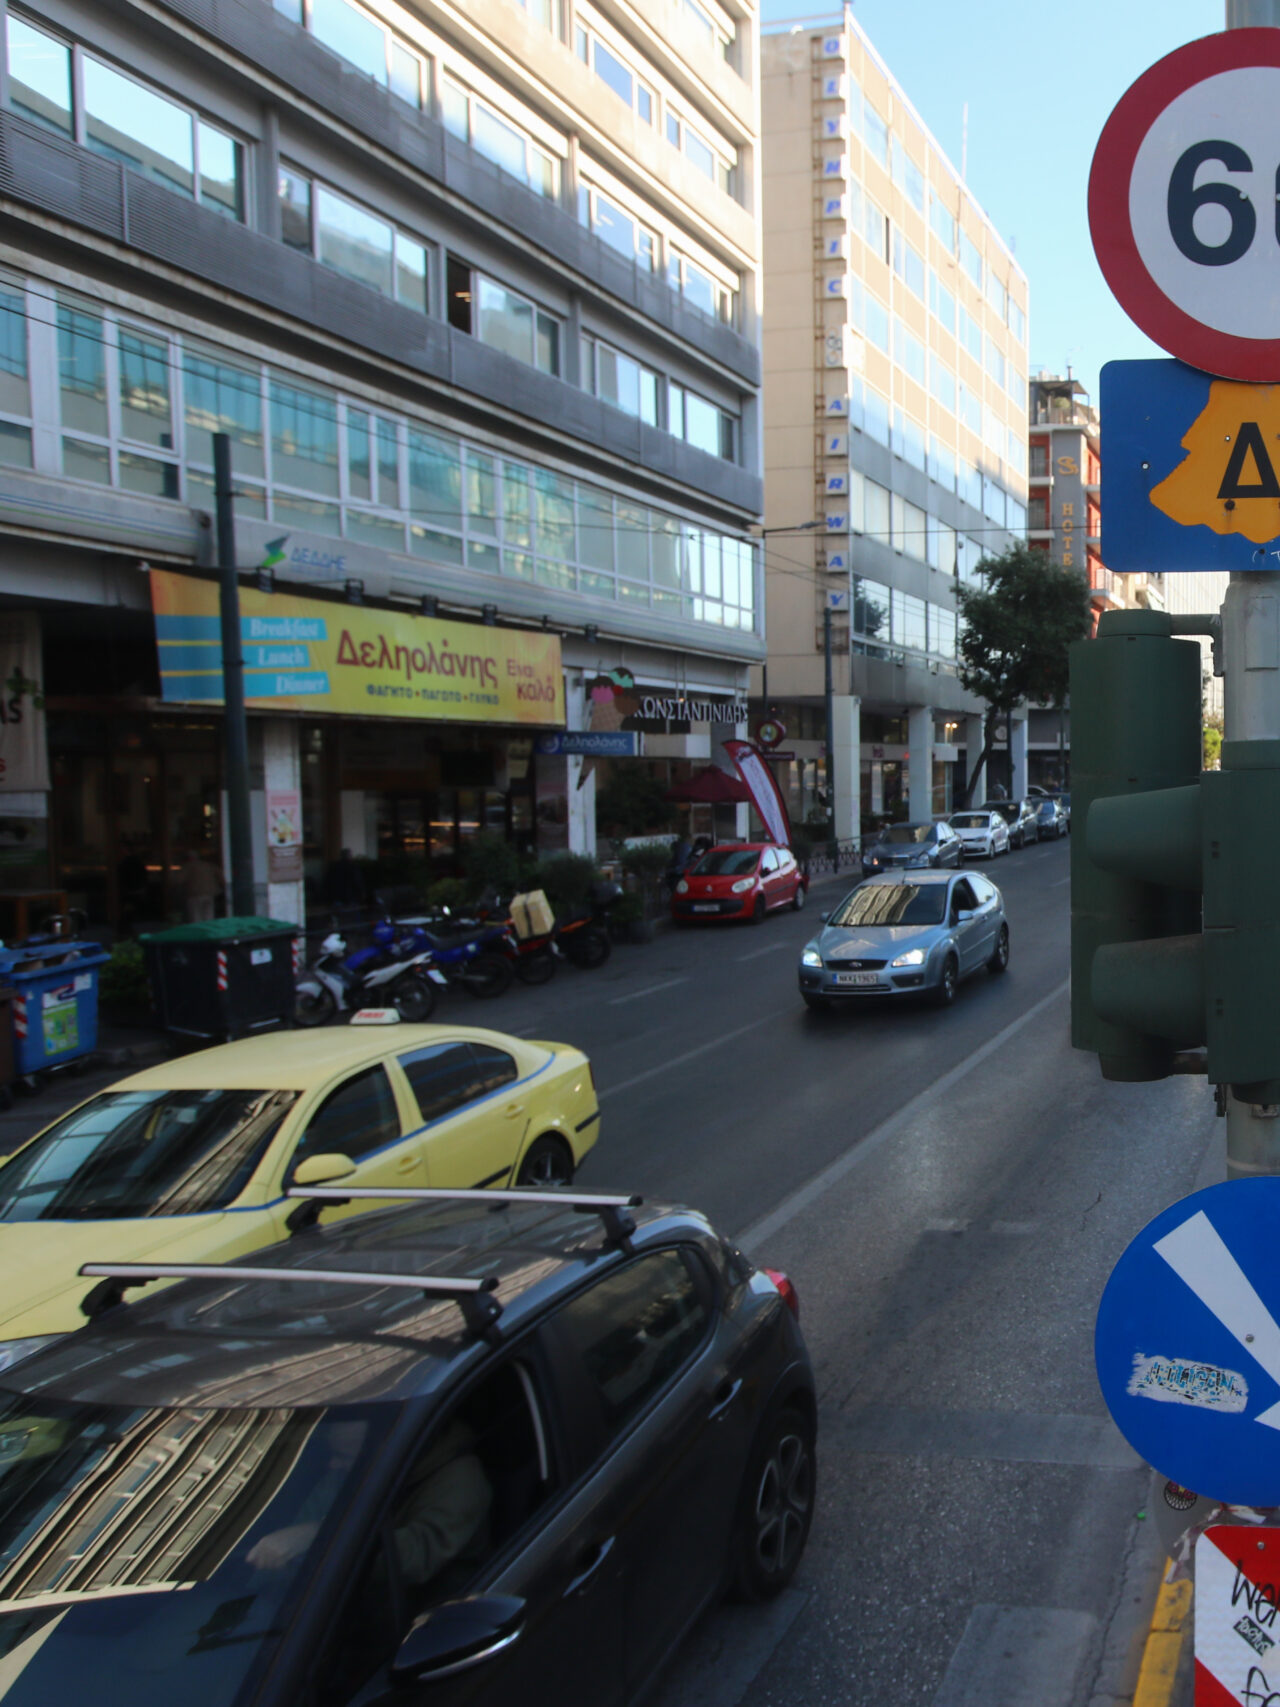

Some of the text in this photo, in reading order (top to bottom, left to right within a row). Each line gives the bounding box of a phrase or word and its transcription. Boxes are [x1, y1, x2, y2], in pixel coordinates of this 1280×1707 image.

[825, 39, 842, 294] OLYMPIC
[1061, 503, 1075, 574] HOTE
[250, 618, 319, 639] Breakfast
[258, 646, 304, 666] Lunch
[336, 628, 498, 689] Δεληολάνης
[275, 675, 326, 695] Dinner
